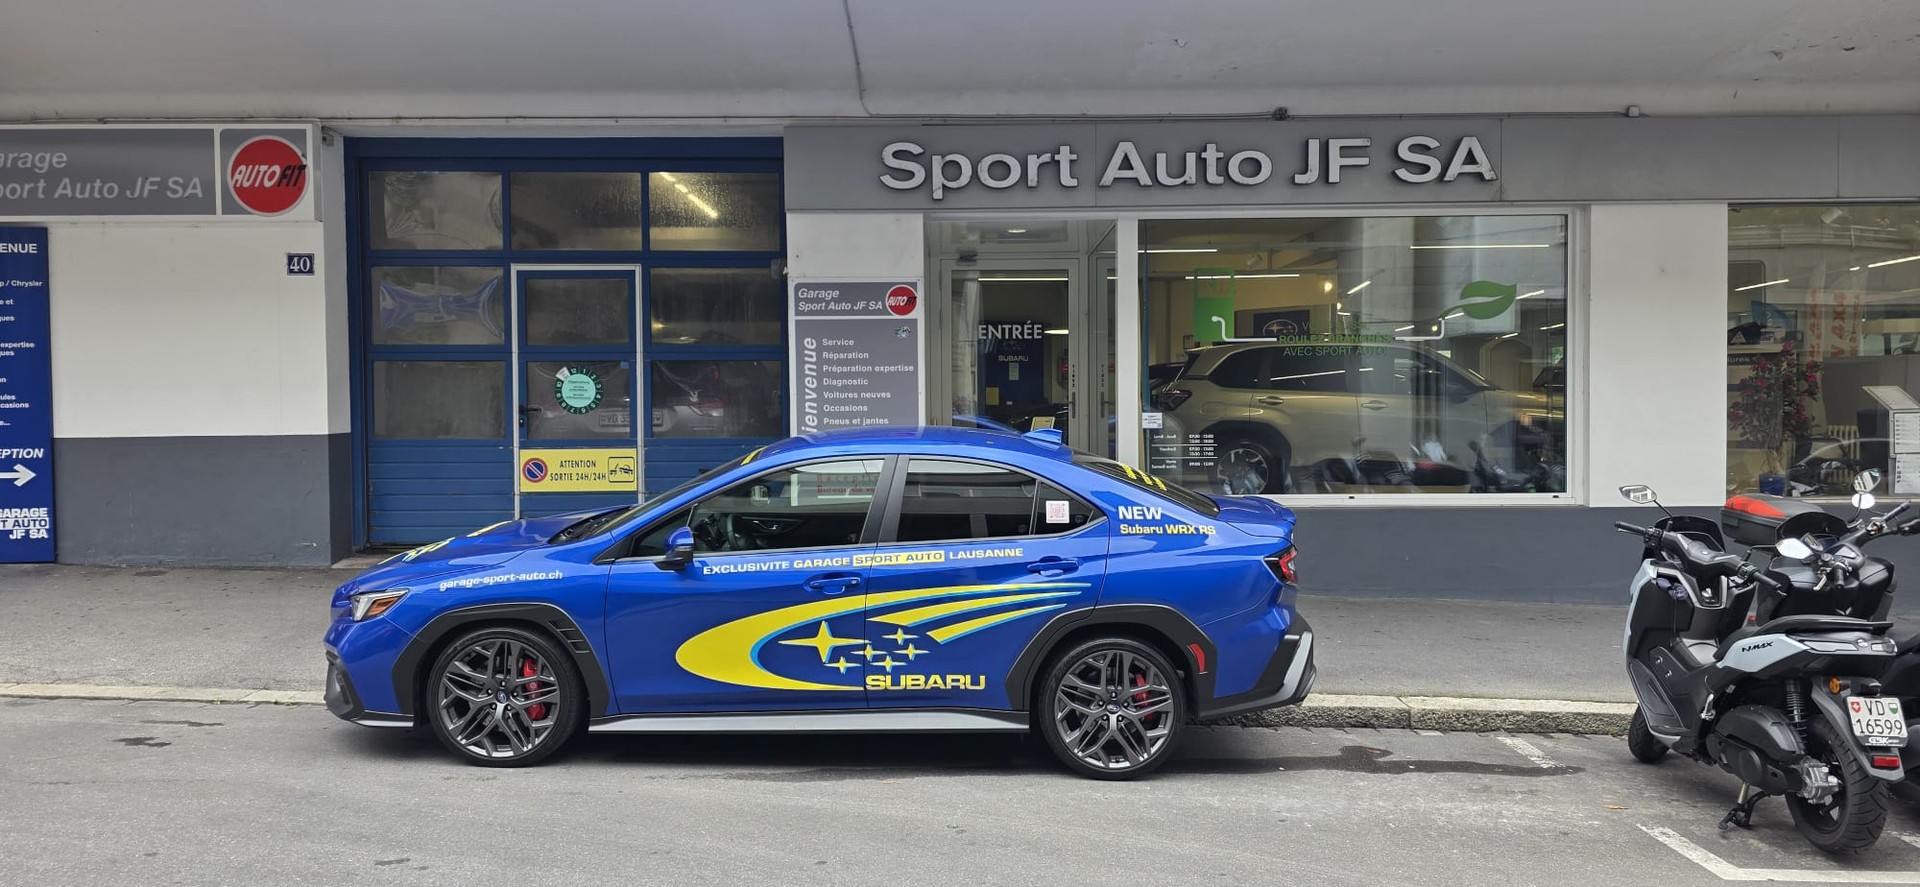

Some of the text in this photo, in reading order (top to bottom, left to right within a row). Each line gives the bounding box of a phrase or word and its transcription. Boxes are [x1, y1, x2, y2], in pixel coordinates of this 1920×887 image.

[879, 135, 1499, 201] Sport Auto JF SA
[0, 177, 204, 199] ort Auto JF SA
[289, 256, 311, 273] 40
[11, 279, 43, 288] Chrysler
[798, 288, 840, 300] Garage
[798, 301, 883, 312] Sport Auto JF SA
[978, 320, 1043, 339] ENTRÉE
[822, 351, 869, 360] Réparation
[1283, 347, 1313, 356] AVEC
[1315, 346, 1351, 356] SPORT
[823, 364, 914, 373] Préparation expertise
[823, 378, 868, 386] Diagnostic
[823, 404, 868, 412] Occasions
[823, 417, 850, 425] Pneus
[863, 417, 889, 426] jantes
[560, 460, 596, 468] ATTENTION
[550, 472, 607, 481] SORTIE 24H/24H
[1118, 506, 1162, 520] NEW
[13, 518, 48, 529] AUTO
[9, 529, 48, 539] JF SA
[1120, 524, 1216, 535] Subaru WRX RS
[703, 548, 1024, 575] EXCLUSIVITE GARAGE SPORT AUTO LAUSANNE
[439, 570, 563, 591] garage-sport-auto.ch
[866, 674, 986, 691] SUBARU
[1864, 700, 1885, 716] VD
[1856, 718, 1903, 735] 16599
